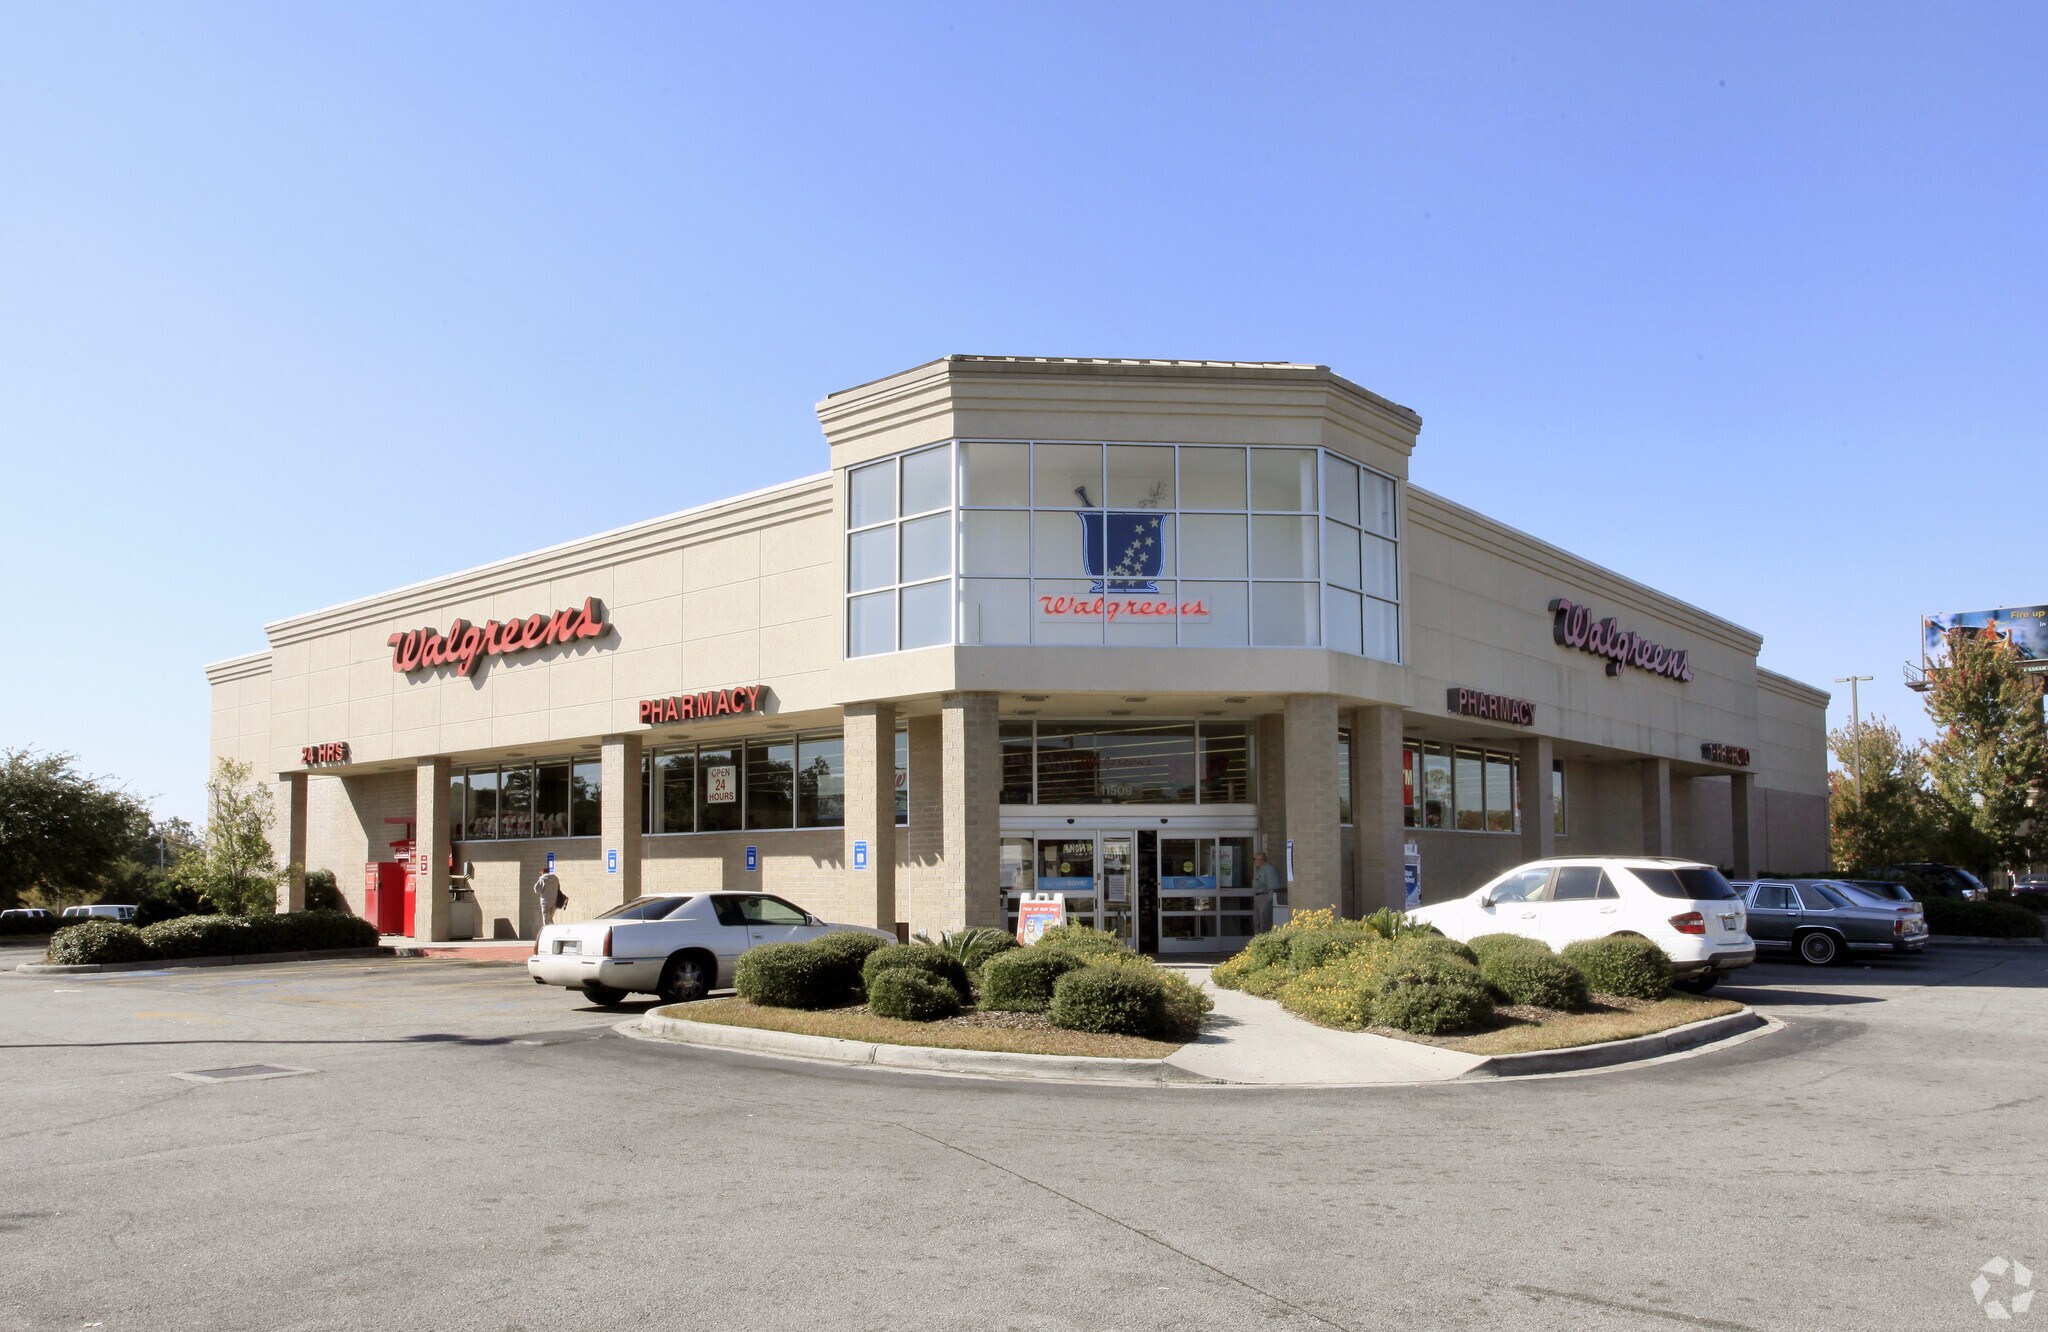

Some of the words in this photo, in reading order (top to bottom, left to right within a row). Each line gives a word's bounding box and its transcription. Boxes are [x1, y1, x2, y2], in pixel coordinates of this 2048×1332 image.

[1040, 596, 1209, 621] Walgreens
[387, 596, 603, 677] Walgreens
[1556, 598, 1694, 682] Walgreens
[639, 685, 760, 724] PHARMACY
[1459, 688, 1536, 726] PHARMACY
[301, 747, 314, 764] 24
[318, 741, 343, 763] HRS
[711, 768, 731, 778] OPEN
[715, 779, 726, 791] 24
[709, 791, 734, 801] HOURS
[1101, 785, 1133, 796] 11509
